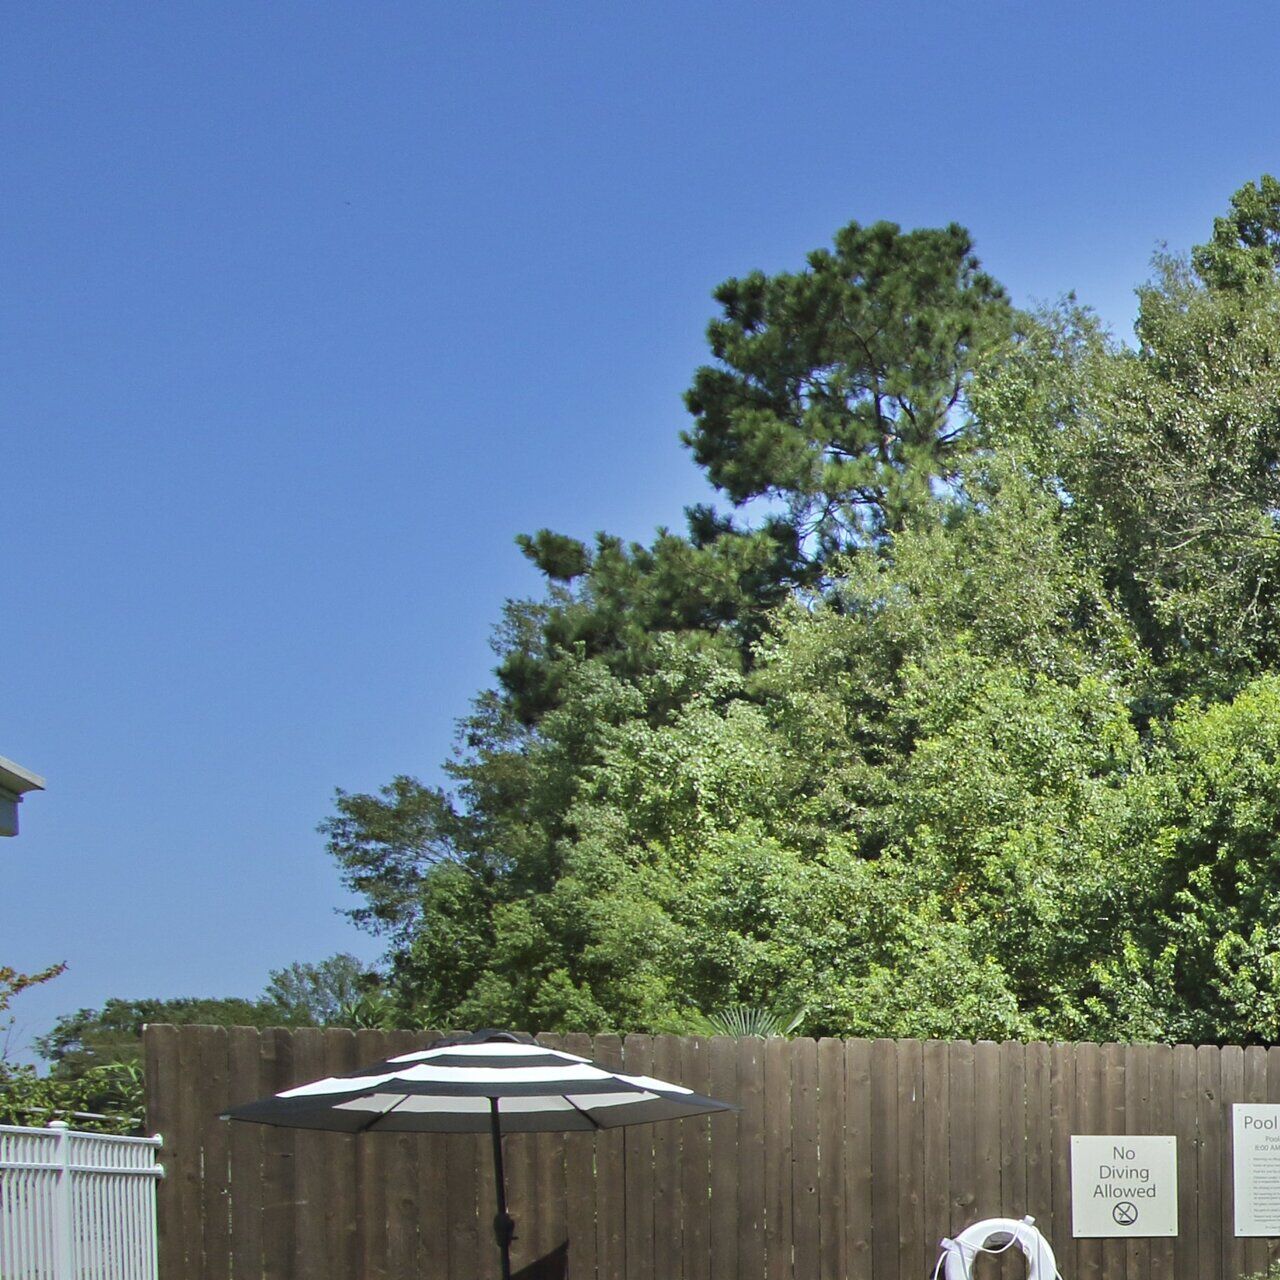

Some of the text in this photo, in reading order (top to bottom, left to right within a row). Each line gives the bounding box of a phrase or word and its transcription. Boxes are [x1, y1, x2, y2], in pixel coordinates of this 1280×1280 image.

[1244, 1115, 1278, 1130] Pool
[1265, 1135, 1280, 1143] Pool
[1113, 1146, 1136, 1160] No
[1099, 1165, 1149, 1183] Diving
[1093, 1184, 1156, 1198] Allowed
